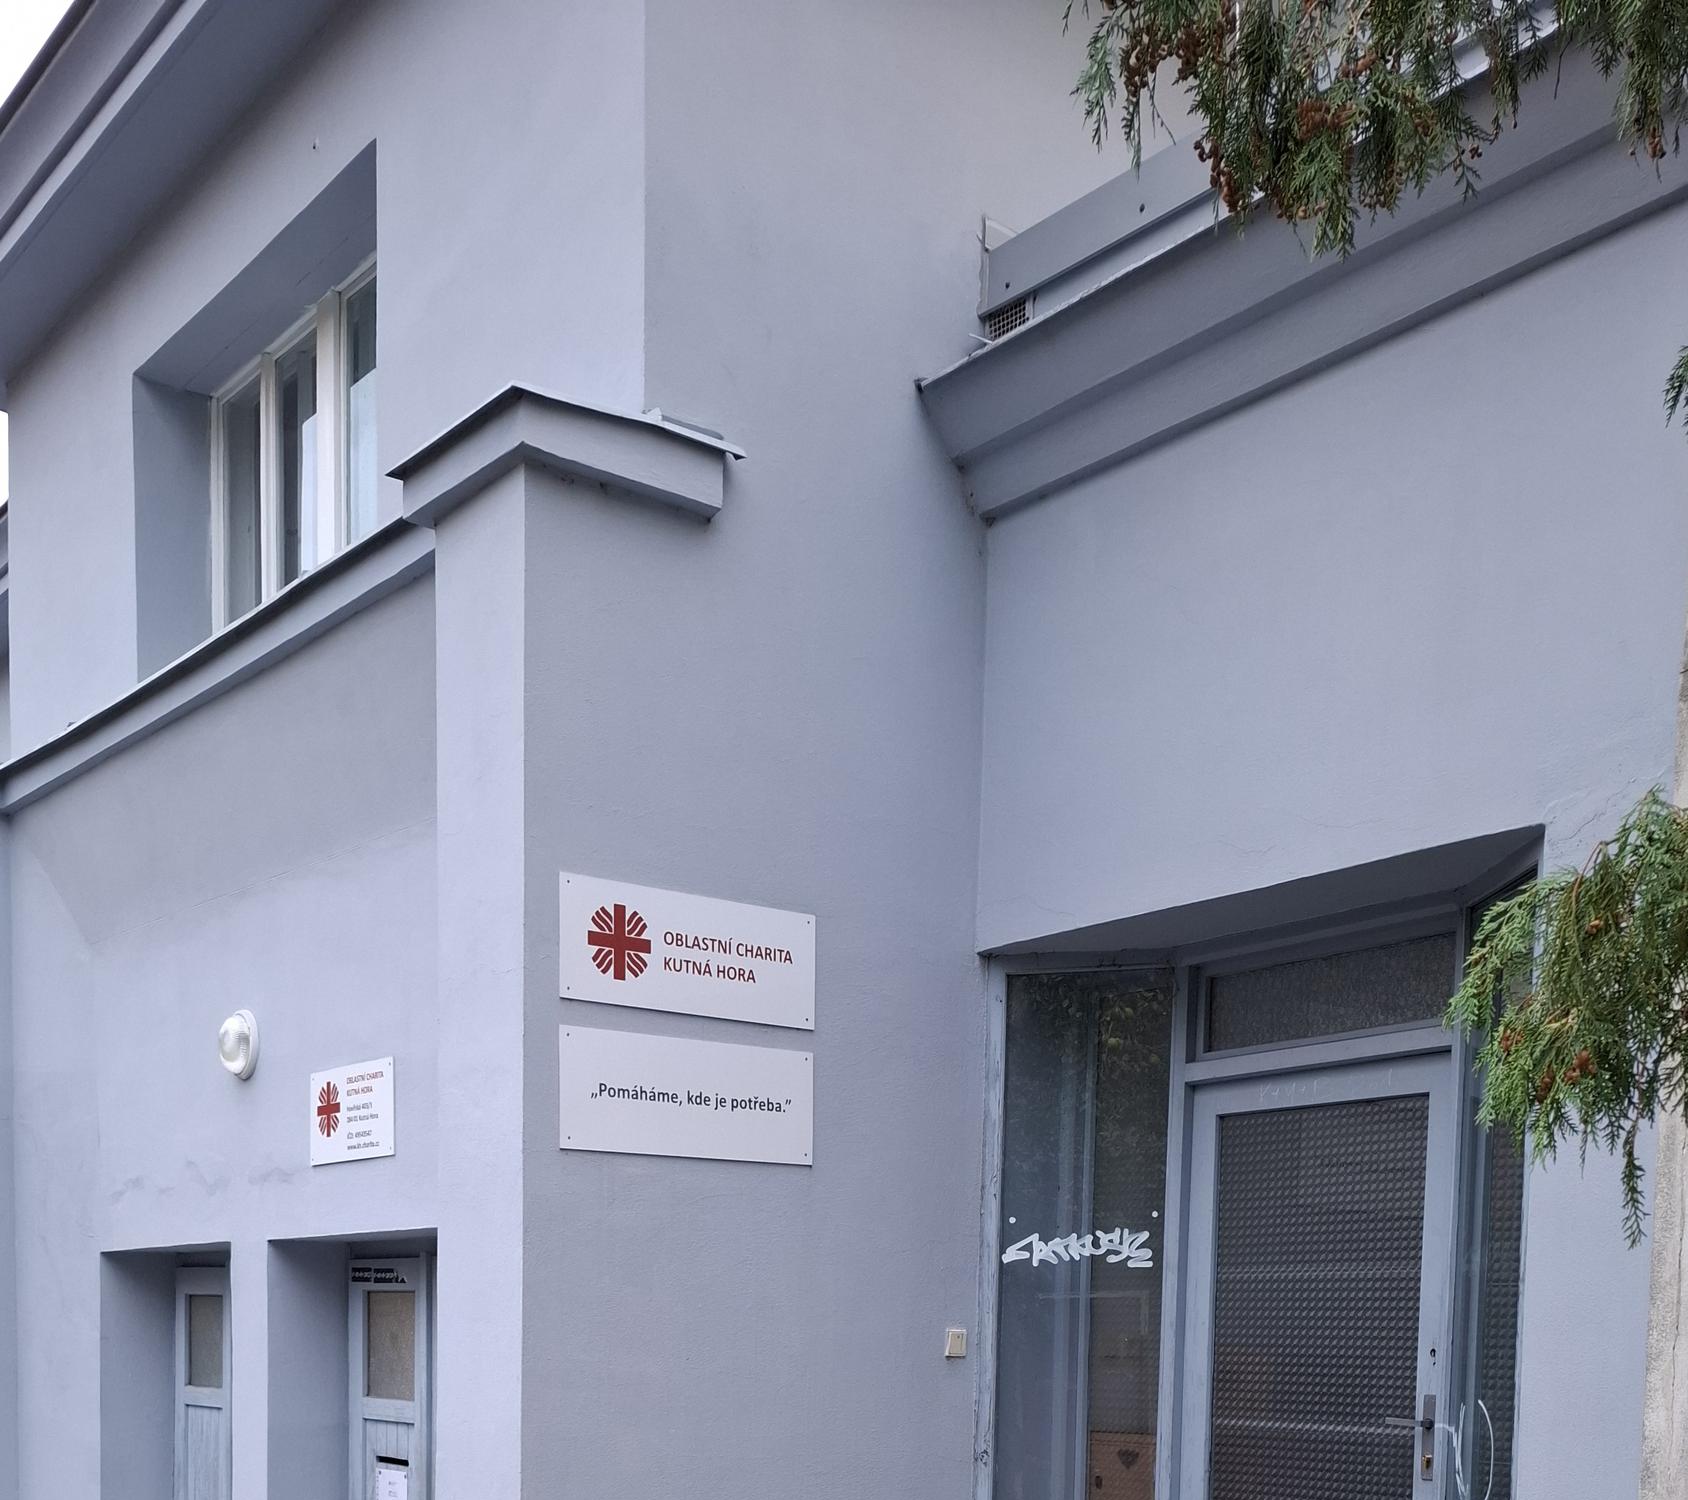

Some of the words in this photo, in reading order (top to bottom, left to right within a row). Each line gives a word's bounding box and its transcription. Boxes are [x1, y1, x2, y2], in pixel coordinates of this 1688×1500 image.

[663, 931, 733, 955] OBLASTNÍ
[736, 942, 793, 965] CHARITA
[663, 956, 713, 977] KUTNÁ
[716, 964, 757, 983] HORA
[687, 1090, 711, 1107] kde
[714, 1093, 727, 1110] je
